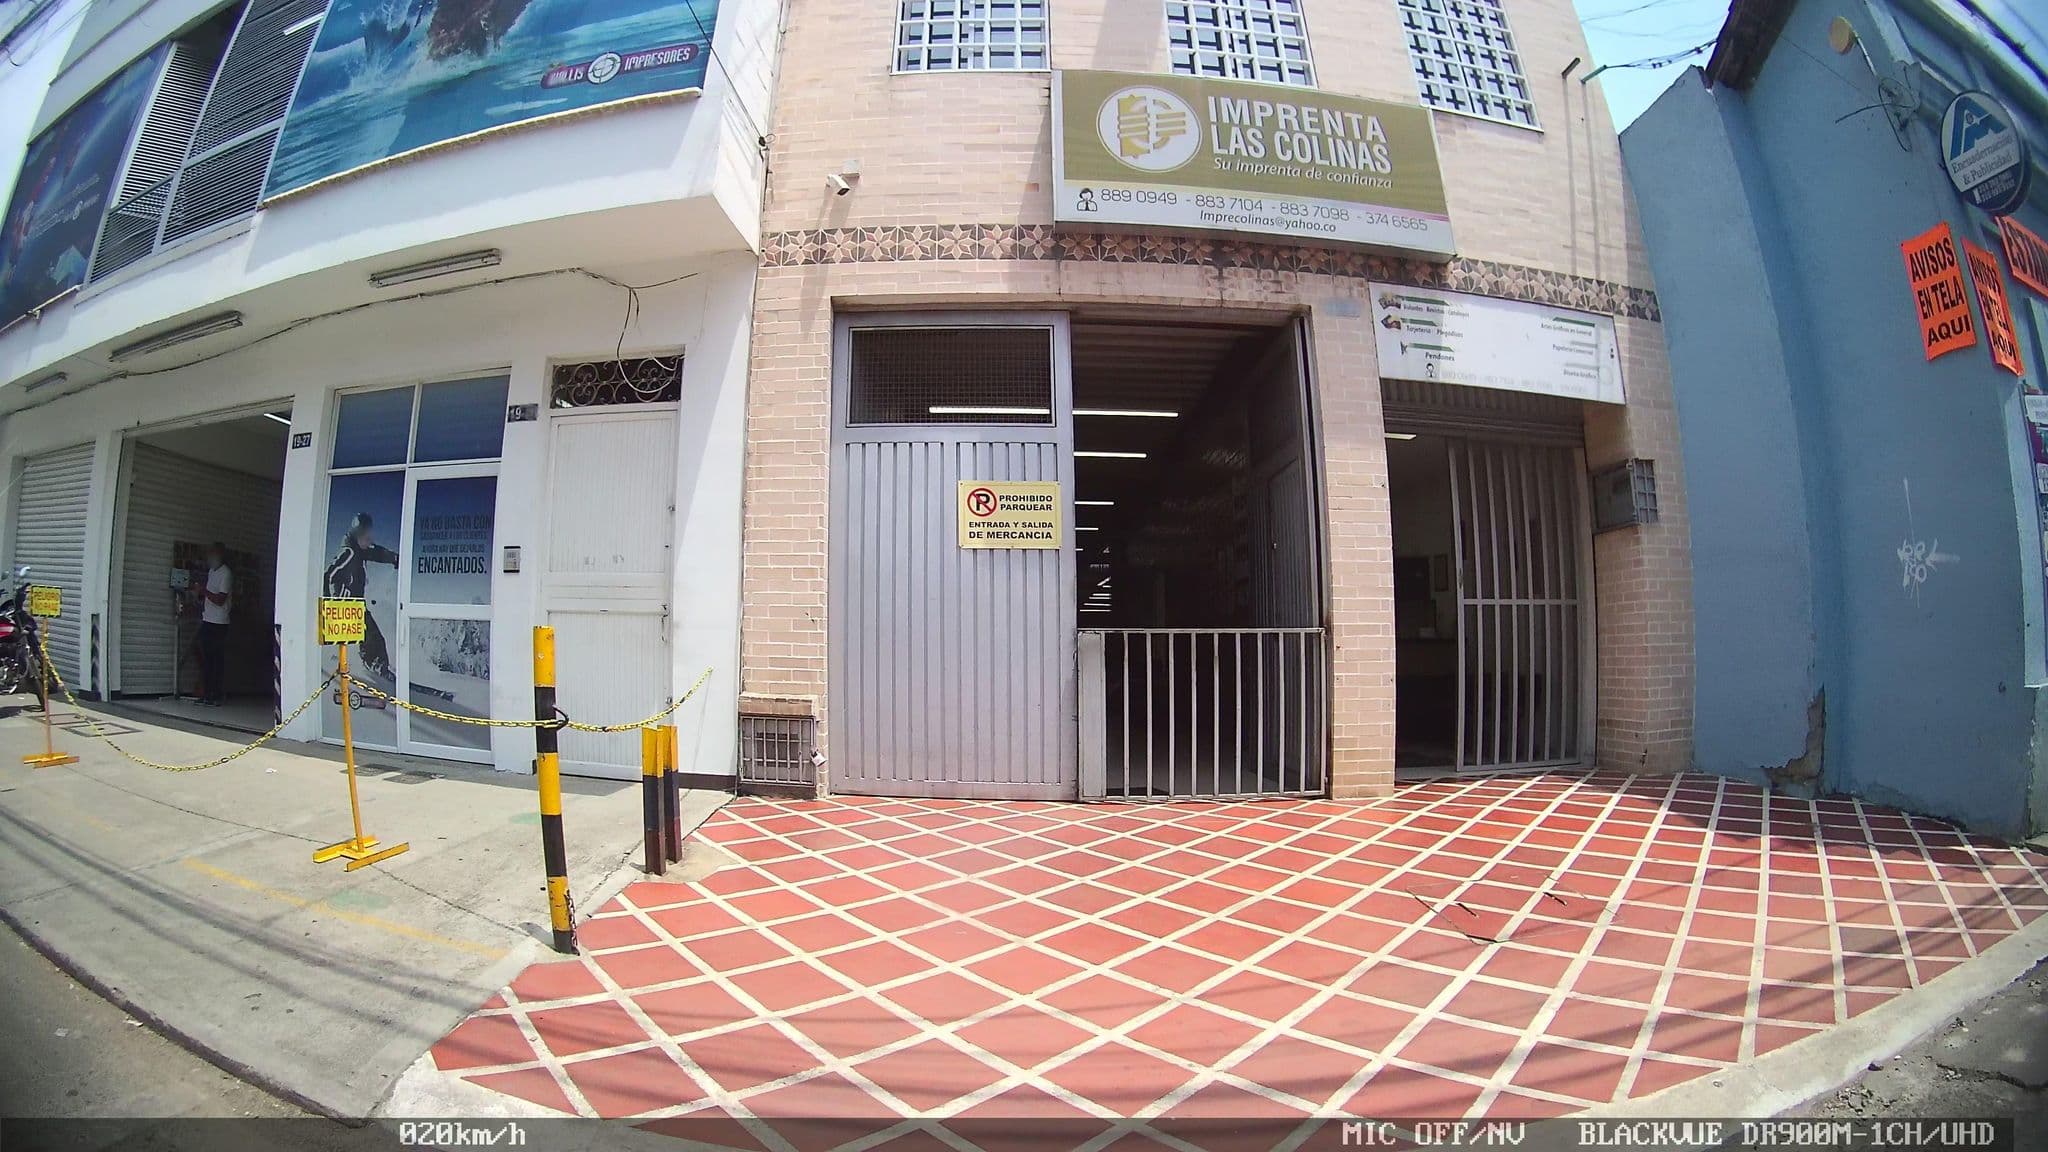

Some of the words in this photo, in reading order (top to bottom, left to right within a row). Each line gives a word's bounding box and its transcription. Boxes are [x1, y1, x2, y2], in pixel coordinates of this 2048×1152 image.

[624, 48, 691, 71] IMPRESORES
[1208, 95, 1388, 144] IMPRENTA
[1211, 124, 1267, 159] LAS
[1274, 131, 1393, 174] COLINAS
[1214, 157, 1233, 170] Su
[1236, 159, 1302, 177] imprenta
[1305, 167, 1323, 180] de
[1326, 171, 1393, 189] confianza
[1100, 188, 1132, 202] 889
[1136, 190, 1177, 205] 0949
[1195, 194, 1225, 209] 883
[1229, 197, 1263, 211] 7104
[1280, 201, 1309, 217] 883
[1313, 205, 1350, 221] 7098
[1366, 212, 1389, 226] 374
[1392, 215, 1428, 231] 6565
[1199, 210, 1336, 232] Imprecolinas@yahoo.co
[1909, 238, 1955, 283] AVISOS
[1918, 287, 1935, 320] EN
[1931, 276, 1965, 313] TELA
[1927, 315, 1971, 347] AQUI
[1425, 351, 1456, 362] Pendones
[999, 494, 1053, 503] PROHIBIDO
[1000, 503, 1053, 512] PARQUEAR
[969, 521, 1011, 529] ENTRADA
[1012, 521, 1020, 529] Y
[1021, 521, 1054, 529] SALIDA
[969, 531, 984, 540] DE
[986, 531, 1053, 540] MERCANCIA
[418, 556, 488, 575] ENCANTADOS.
[326, 607, 363, 620] PELIGRO
[328, 623, 340, 635] NO
[341, 623, 362, 634] PASE
